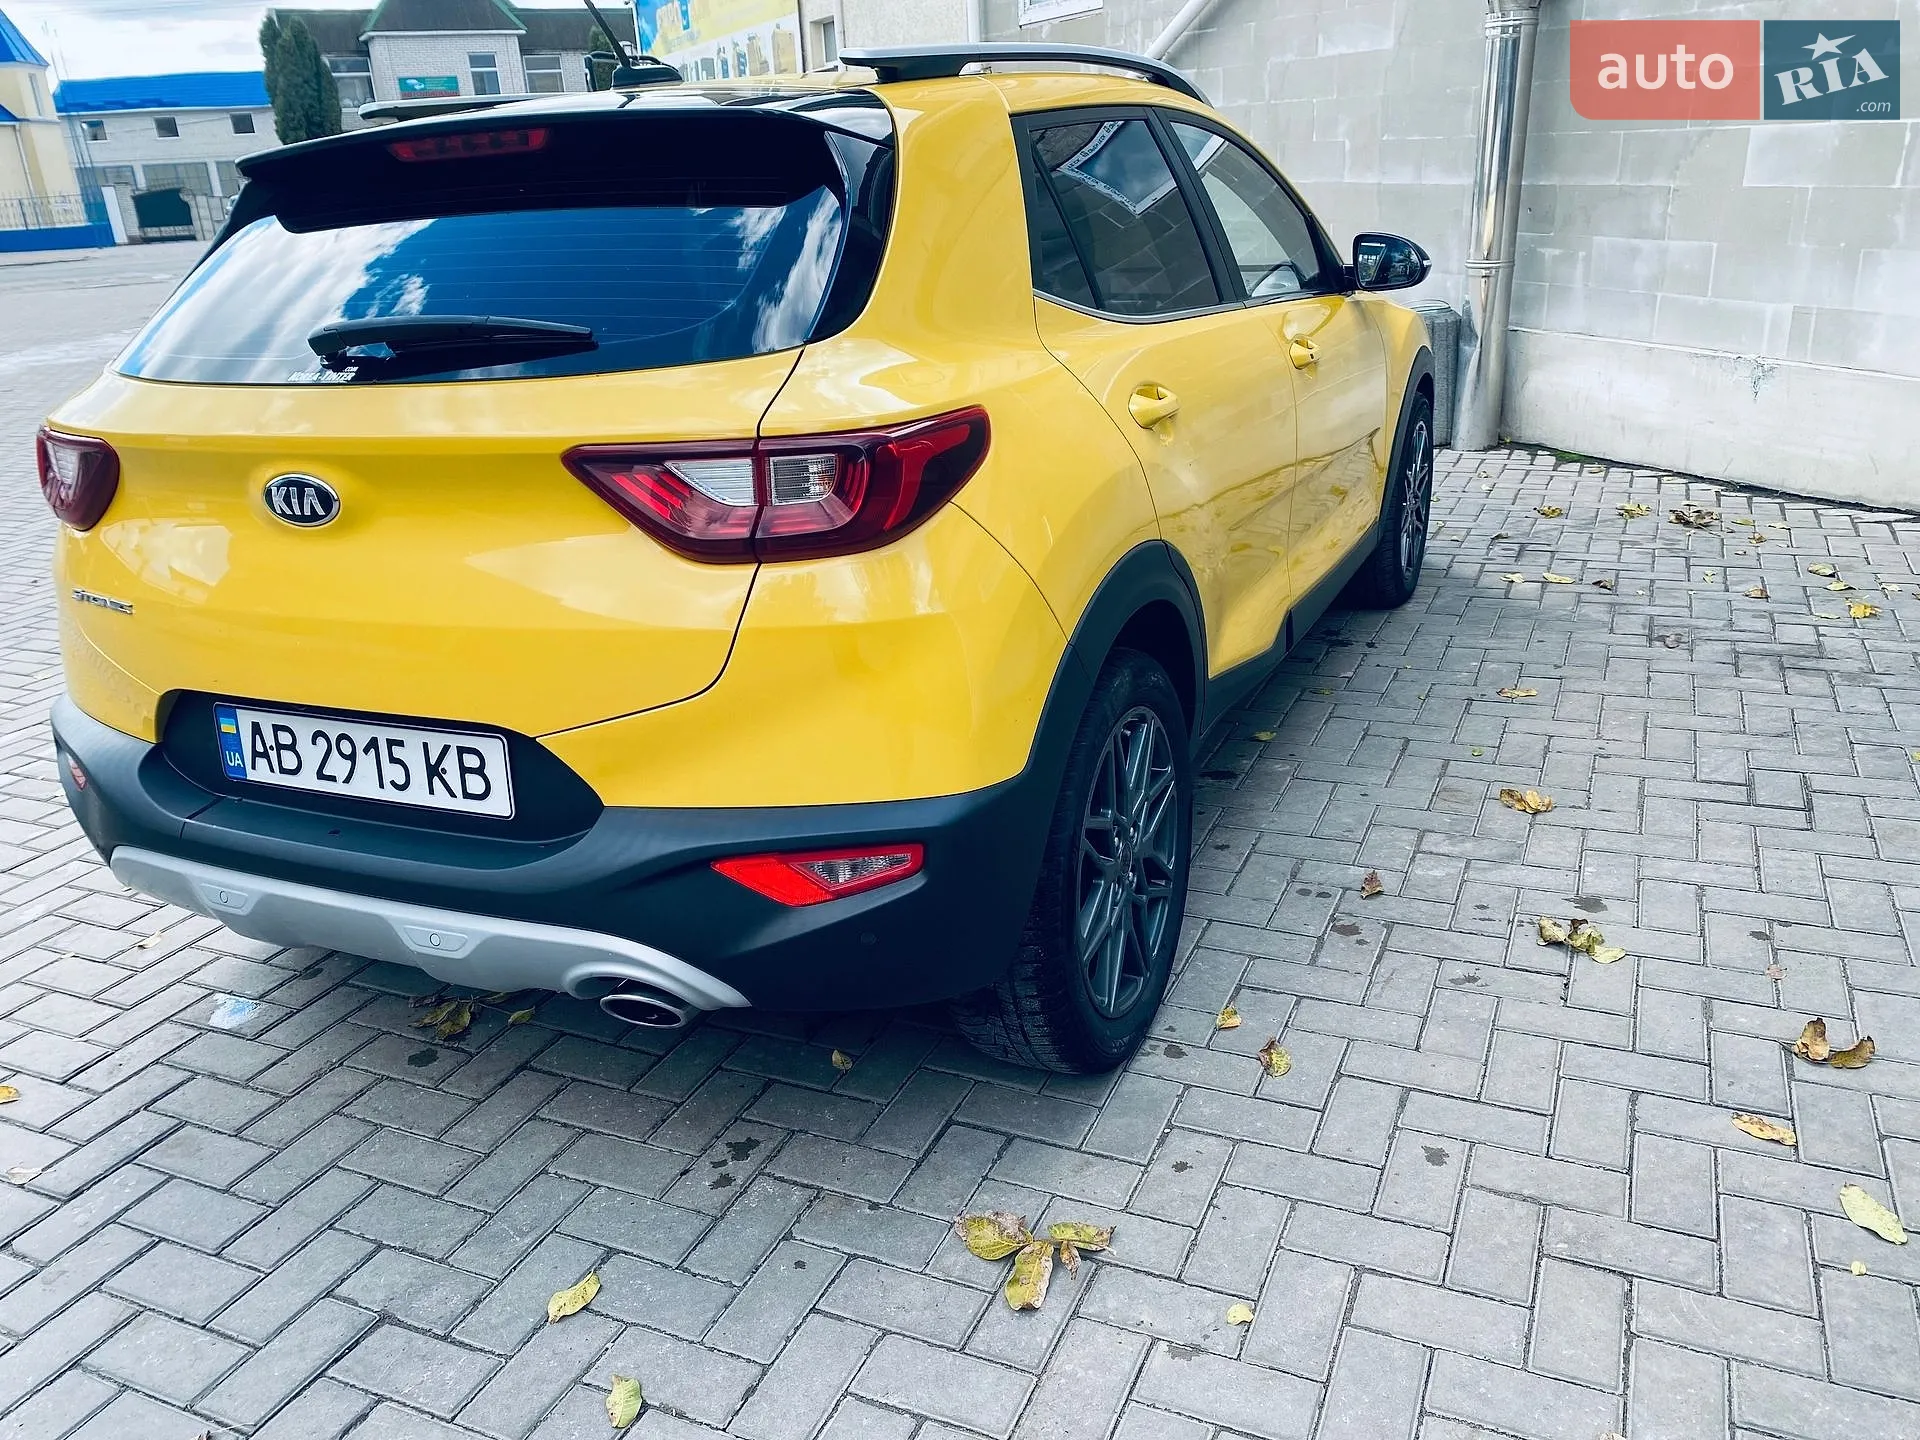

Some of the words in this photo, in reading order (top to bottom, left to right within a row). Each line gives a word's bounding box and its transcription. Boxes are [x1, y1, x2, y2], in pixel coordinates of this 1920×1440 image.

[270, 486, 326, 516] KIA
[226, 751, 244, 768] UA
[250, 720, 303, 776] AB
[310, 729, 412, 792] 2915
[421, 741, 492, 801] KB
